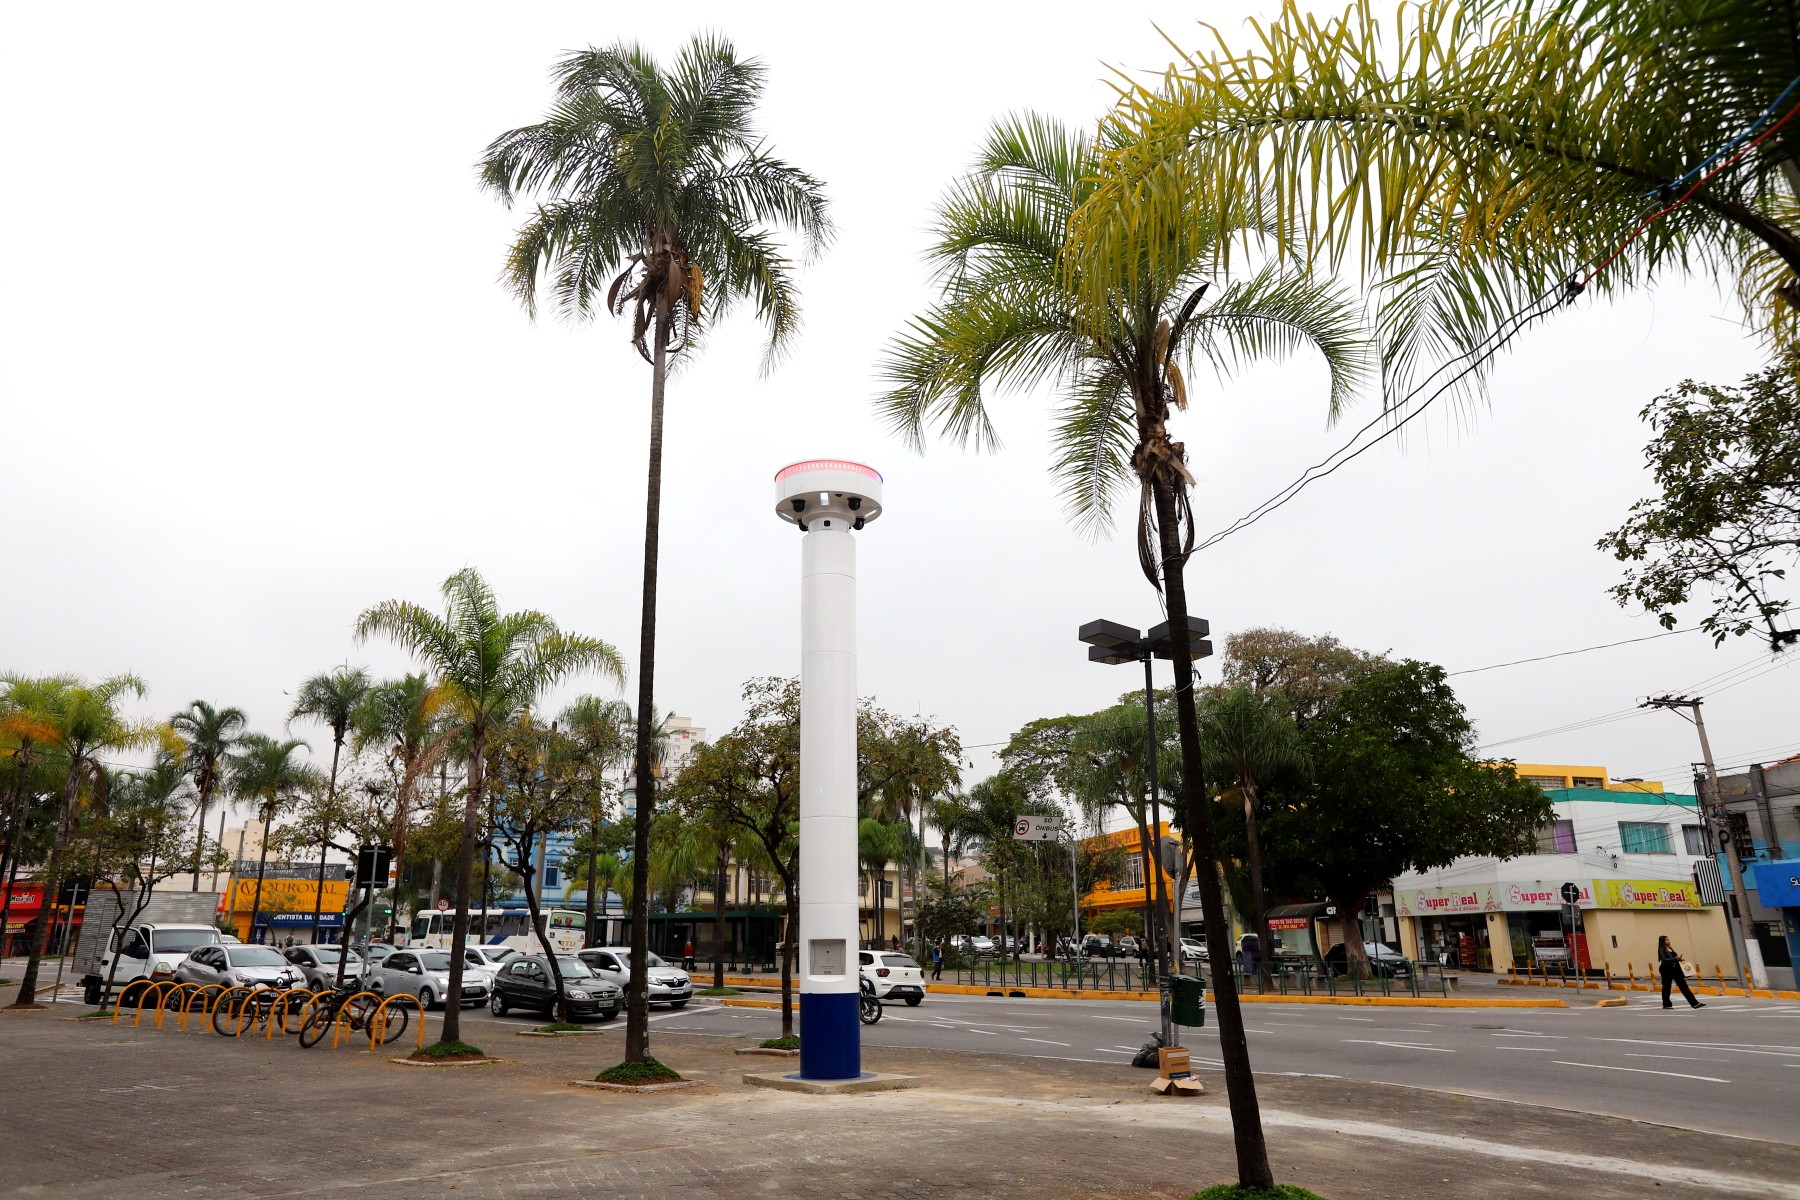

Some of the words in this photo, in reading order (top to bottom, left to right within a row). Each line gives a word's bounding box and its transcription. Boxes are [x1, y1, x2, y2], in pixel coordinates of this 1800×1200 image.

[1035, 824, 1059, 832] ÔNIBUS
[261, 881, 337, 895] OUROVAL
[1659, 888, 1687, 902] Real
[1451, 892, 1479, 907] Real
